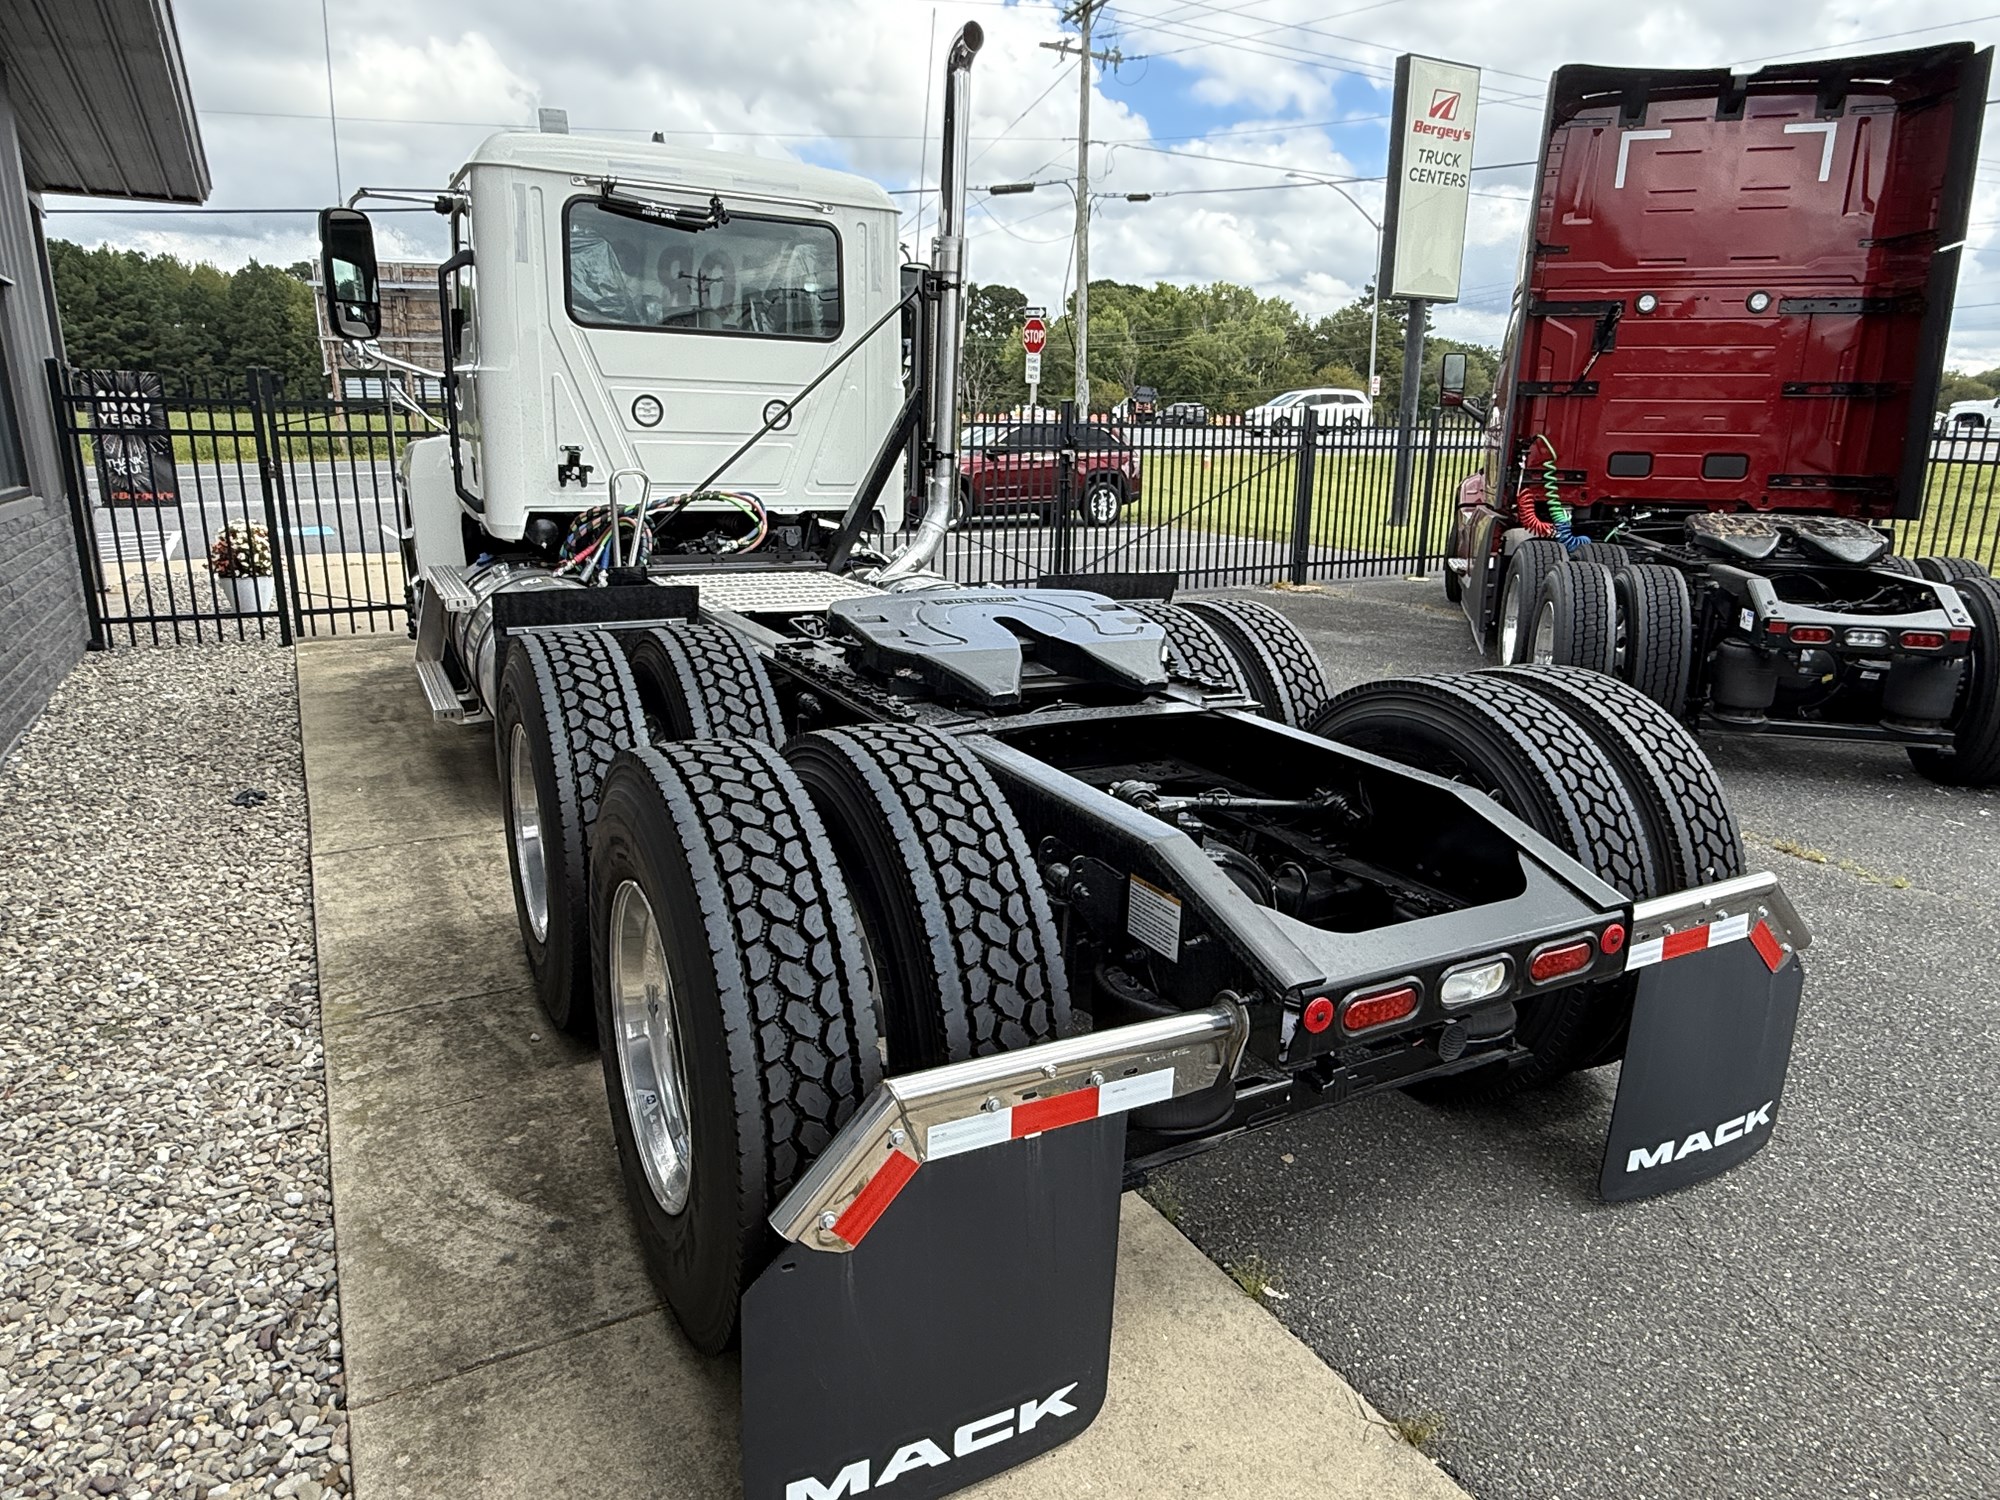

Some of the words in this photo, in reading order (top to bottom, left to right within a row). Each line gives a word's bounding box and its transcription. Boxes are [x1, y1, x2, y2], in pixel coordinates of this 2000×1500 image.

[1413, 120, 1471, 141] Bergey's
[1419, 148, 1461, 168] TRUCK
[1409, 167, 1467, 188] CENTERS
[1024, 329, 1045, 343] STOP
[98, 412, 151, 425] YEARS
[1626, 1100, 1773, 1173] MACK
[786, 1381, 1078, 1500] MACK
